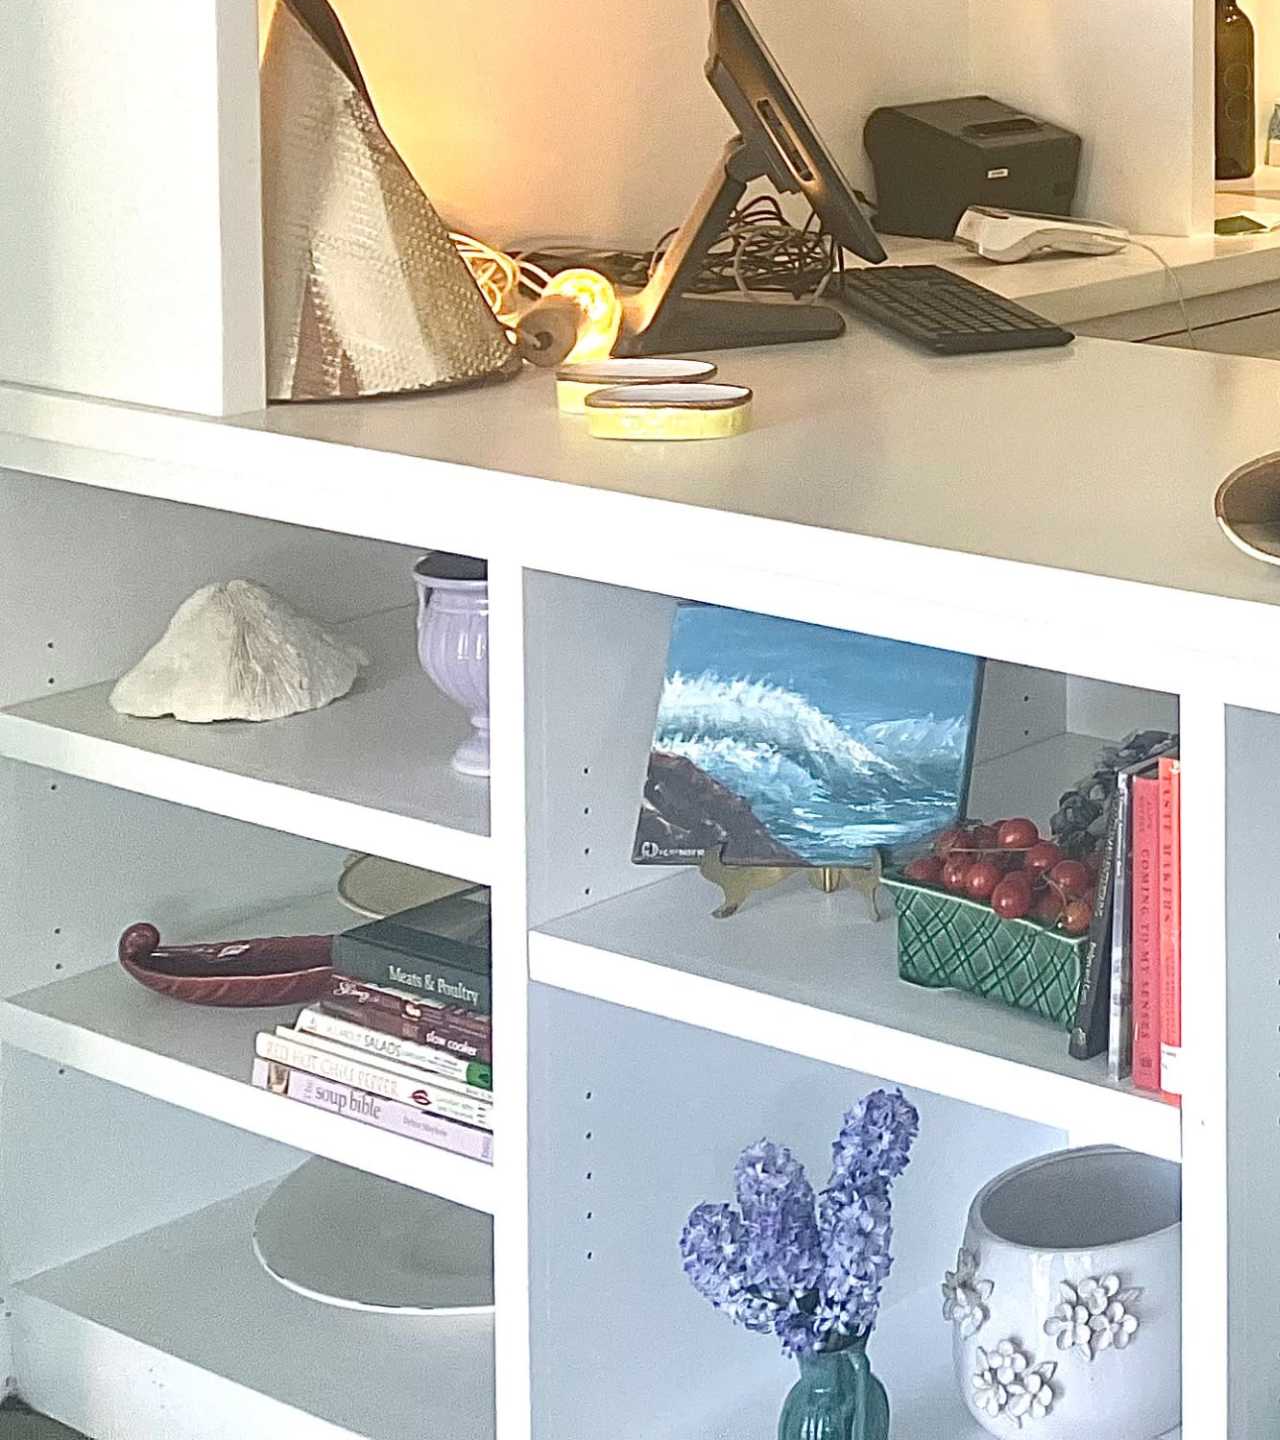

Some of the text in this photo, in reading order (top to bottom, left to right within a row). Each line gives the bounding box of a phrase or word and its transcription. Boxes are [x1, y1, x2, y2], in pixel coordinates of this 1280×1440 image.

[1138, 849, 1151, 1039] COMING TO MY SENSES
[388, 964, 480, 1004] Meats & Poultry
[363, 1033, 402, 1057] SALADS
[425, 1030, 445, 1047] slow
[447, 1038, 478, 1055] cooker
[314, 1086, 347, 1110] soup
[348, 1091, 382, 1121] bible
